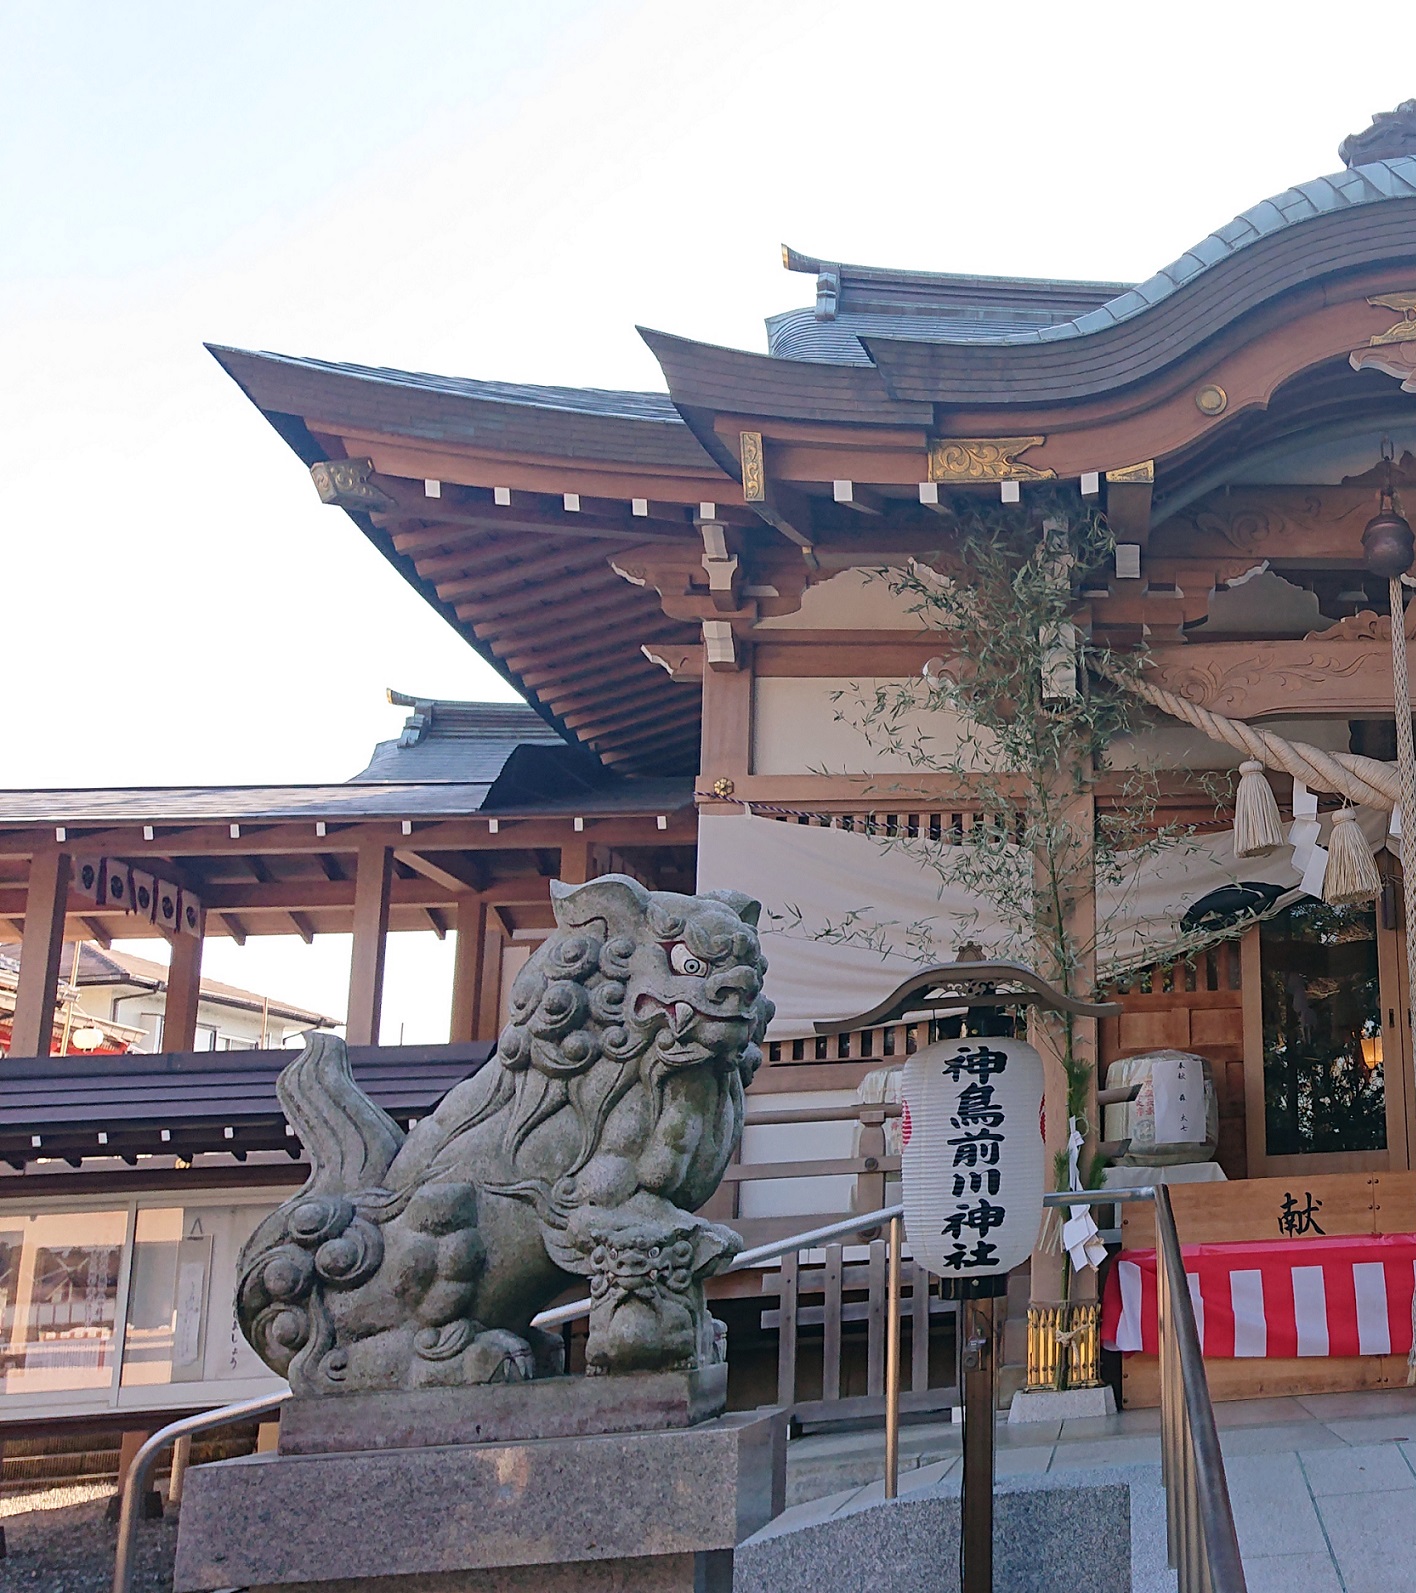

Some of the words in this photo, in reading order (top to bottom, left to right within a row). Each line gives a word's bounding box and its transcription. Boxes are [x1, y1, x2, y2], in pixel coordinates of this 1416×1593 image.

[941, 1046, 1008, 1271] 神鳥前川神社
[1277, 1192, 1326, 1238] 献
